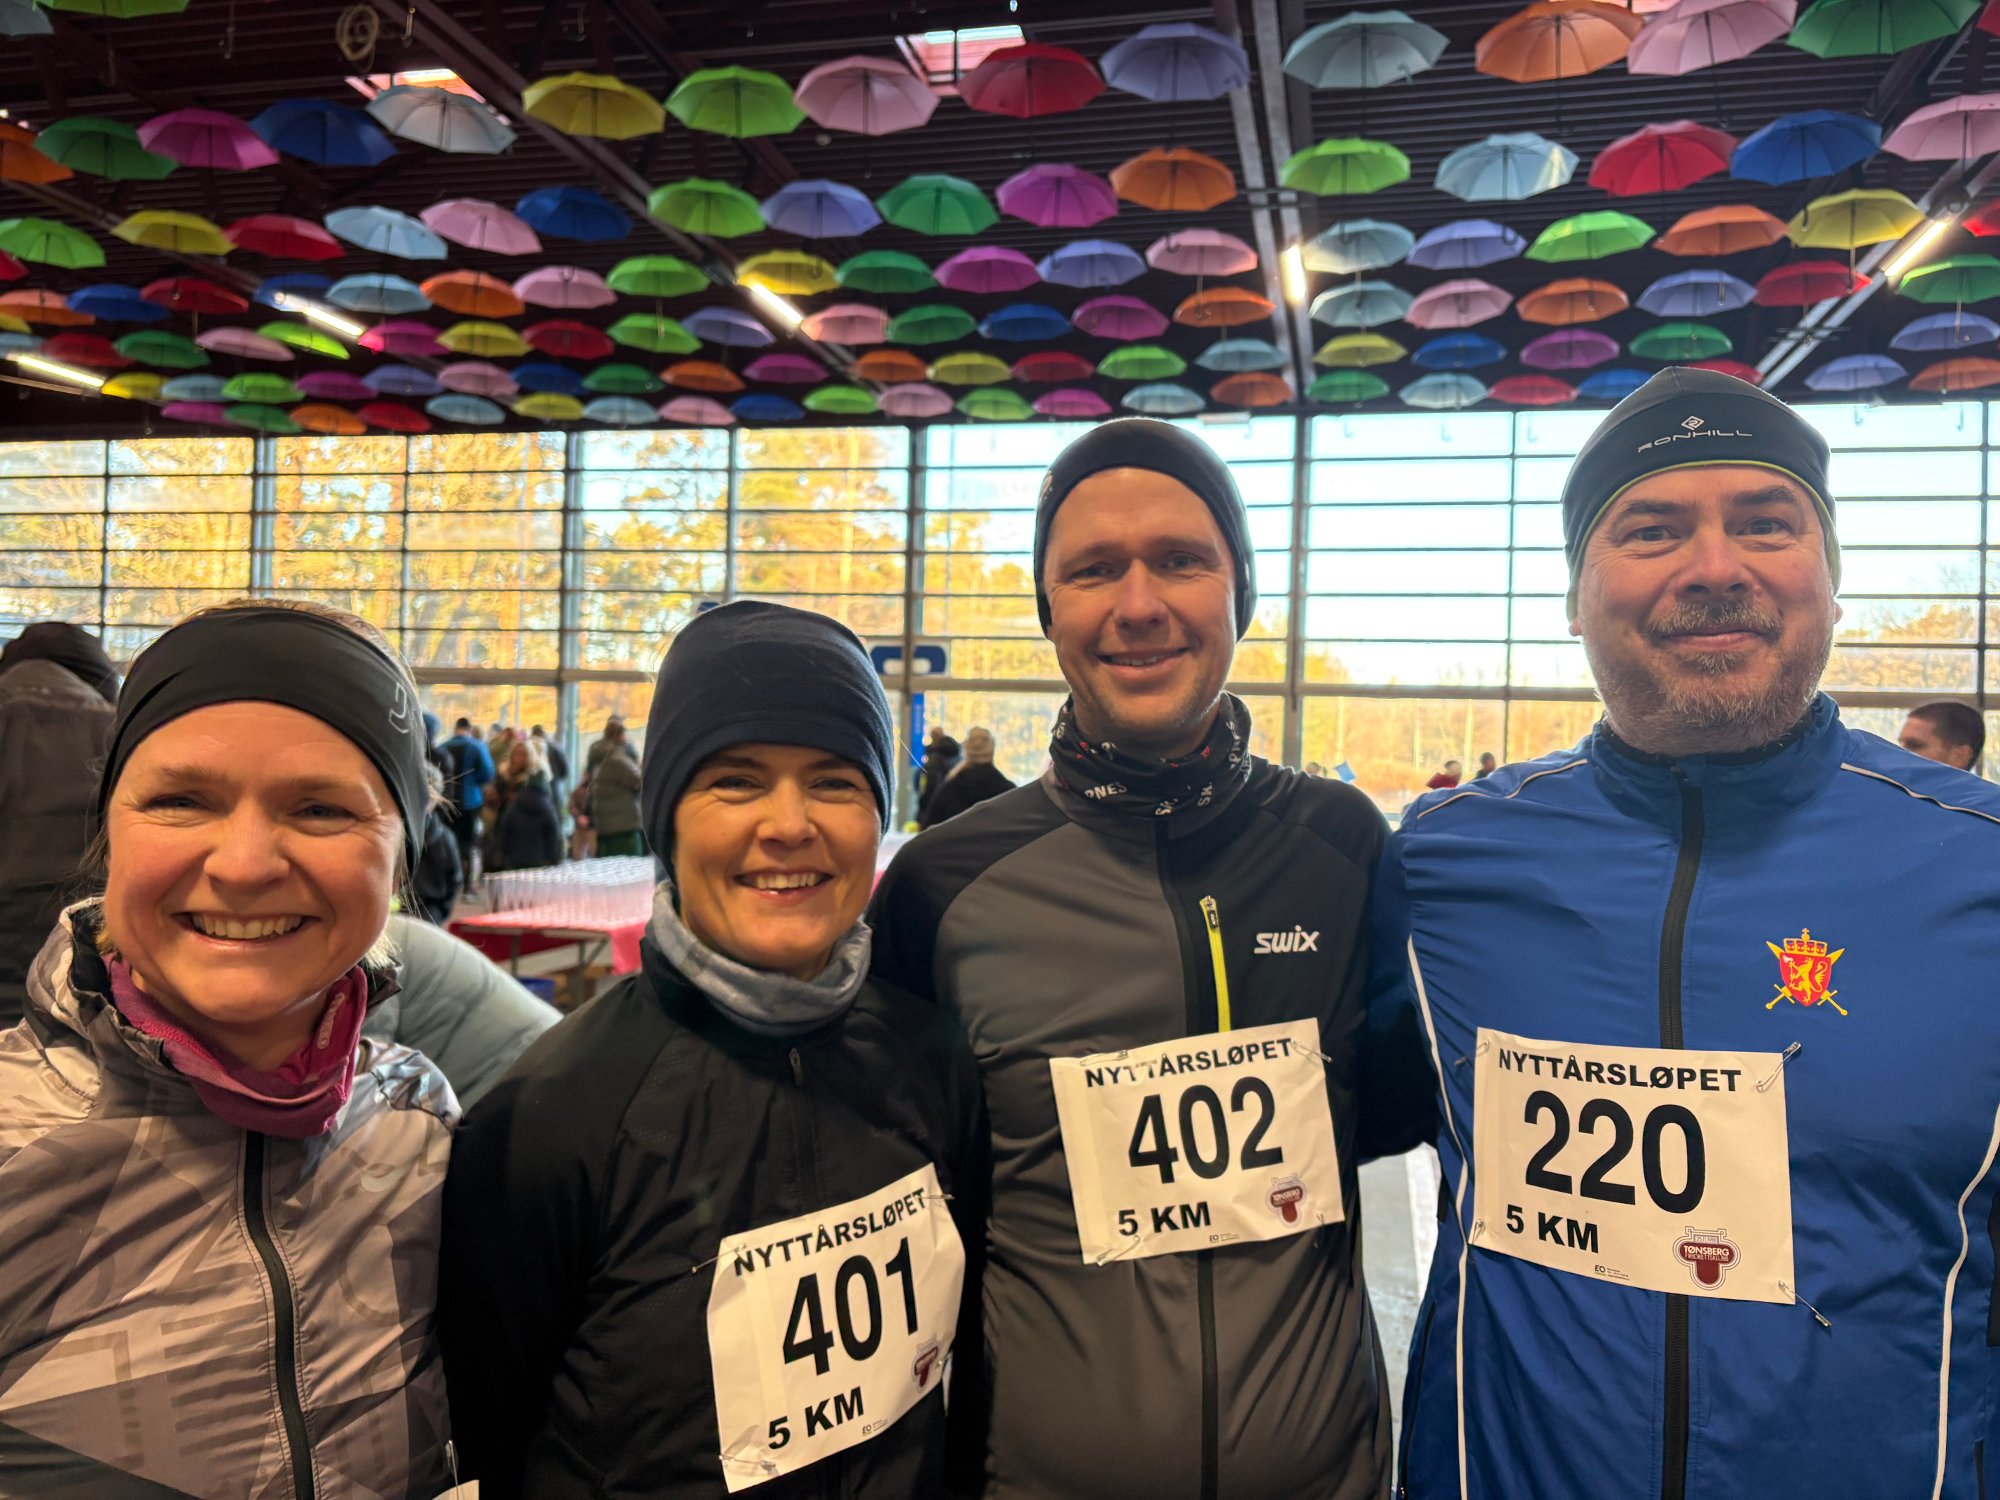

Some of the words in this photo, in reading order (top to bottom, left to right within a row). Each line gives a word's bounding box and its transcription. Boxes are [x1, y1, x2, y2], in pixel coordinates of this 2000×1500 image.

[1085, 1037, 1292, 1088] NYTTÅRSLØPET
[1499, 1047, 1742, 1092] NYTTÅRSLØPET
[1128, 1076, 1284, 1184] 402
[1524, 1090, 1706, 1214] 220
[733, 1187, 926, 1277] NYTTÅRSLØPET
[1118, 1209, 1139, 1237] 5
[1151, 1201, 1212, 1233] KM
[1506, 1204, 1525, 1234] 5
[1538, 1211, 1599, 1254] KM
[1683, 1245, 1730, 1256] TØNSBERG
[782, 1236, 918, 1376] 401
[767, 1416, 791, 1450] 5
[804, 1386, 865, 1438] KM
